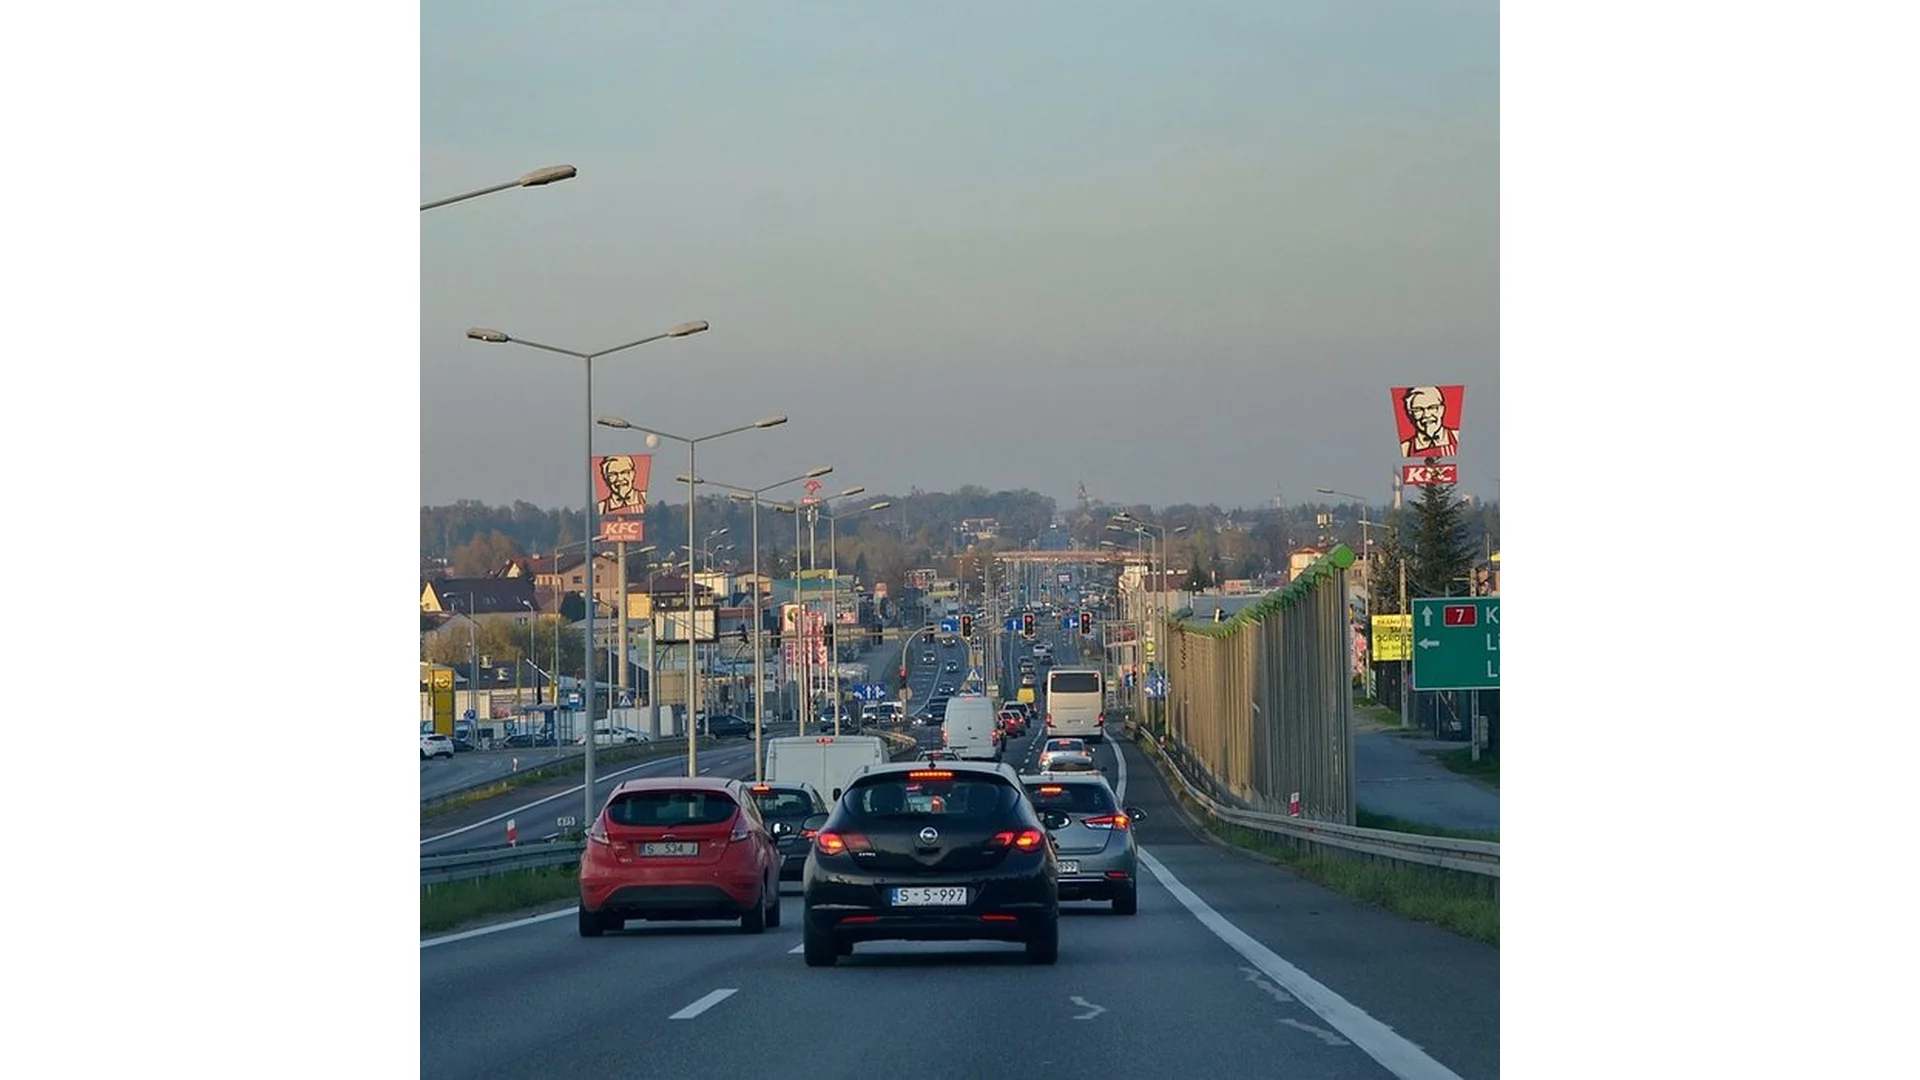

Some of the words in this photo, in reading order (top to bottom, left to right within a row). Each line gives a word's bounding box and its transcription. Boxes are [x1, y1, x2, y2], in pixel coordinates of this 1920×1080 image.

[605, 522, 639, 534] KFC
[1456, 609, 1464, 623] 7
[1486, 606, 1499, 624] K
[1487, 660, 1500, 678] L
[646, 843, 655, 854] S
